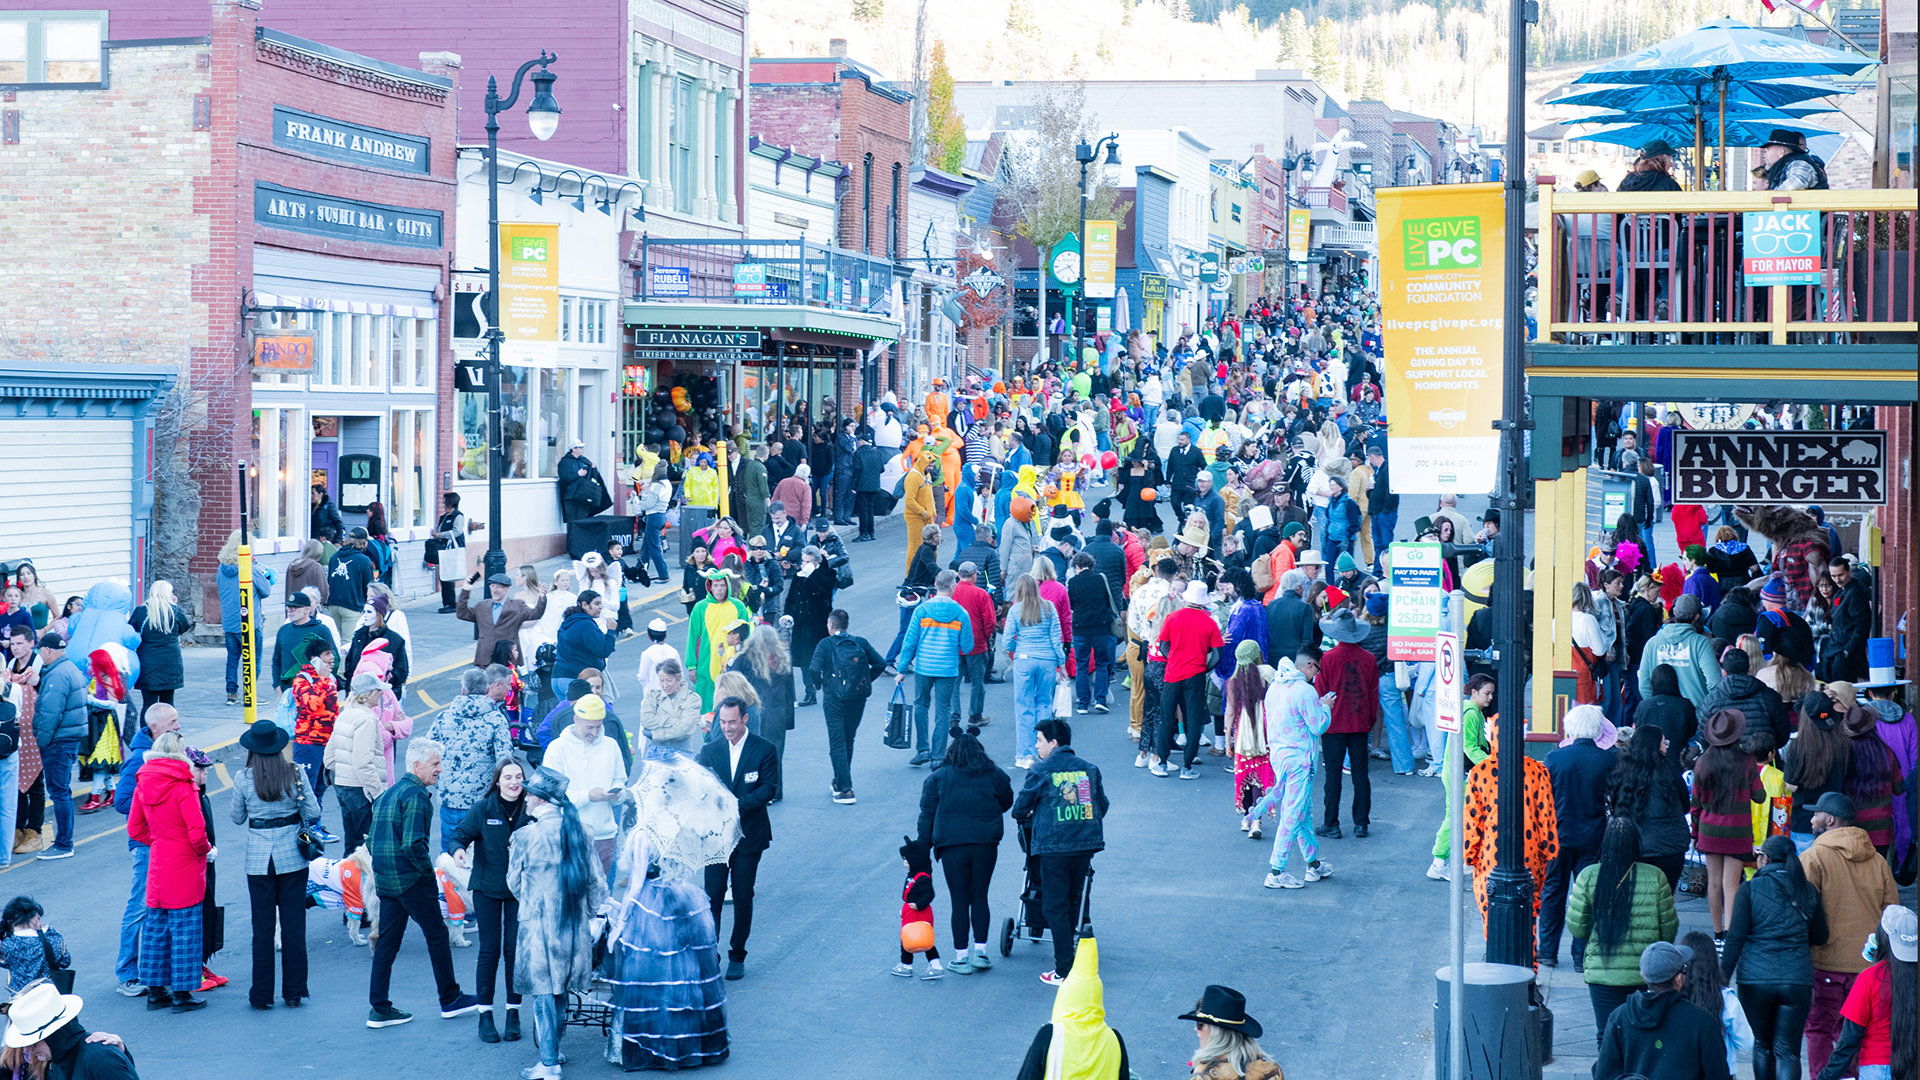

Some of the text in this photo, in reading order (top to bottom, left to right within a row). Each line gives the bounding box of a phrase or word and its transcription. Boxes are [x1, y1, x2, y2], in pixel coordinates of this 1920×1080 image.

[286, 120, 417, 163] FRANK ANDREW
[268, 198, 432, 237] ARTS SUSHI BAR GIFTS
[1752, 214, 1812, 232] JACK
[1427, 220, 1476, 238] GIVE
[514, 238, 522, 258] LIVE
[522, 239, 545, 247] GIVE
[1408, 224, 1426, 266] LIVE
[523, 247, 546, 260] PC
[1428, 238, 1478, 266] PC
[1752, 258, 1812, 272] FOR MAYOR
[654, 275, 688, 284] RUBELL
[1406, 280, 1482, 293] COMMUNITY
[1406, 291, 1482, 304] FOUNDATION
[1387, 317, 1502, 332] livepcgivepc.org
[650, 333, 747, 344] FLANAGAN'S
[262, 342, 307, 356] PANDO
[1414, 346, 1479, 356] THE ANNUAL
[1410, 357, 1483, 367] GIVING DAY TO
[1405, 368, 1488, 379] SUPPORT LOCAL
[1414, 381, 1480, 390] NONPROFITS
[1679, 436, 1858, 468] ANNEX
[1459, 459, 1478, 467] CITY
[1679, 468, 1881, 499] BURGER
[1407, 551, 1424, 560] GO
[1396, 595, 1436, 606] PCMAIN
[1398, 613, 1433, 624] 25023
[241, 622, 250, 660] DLS
[1444, 688, 1450, 698] NO
[1439, 698, 1456, 711] PARKING
[745, 771, 758, 782] 456
[1057, 805, 1086, 822] LOVE
